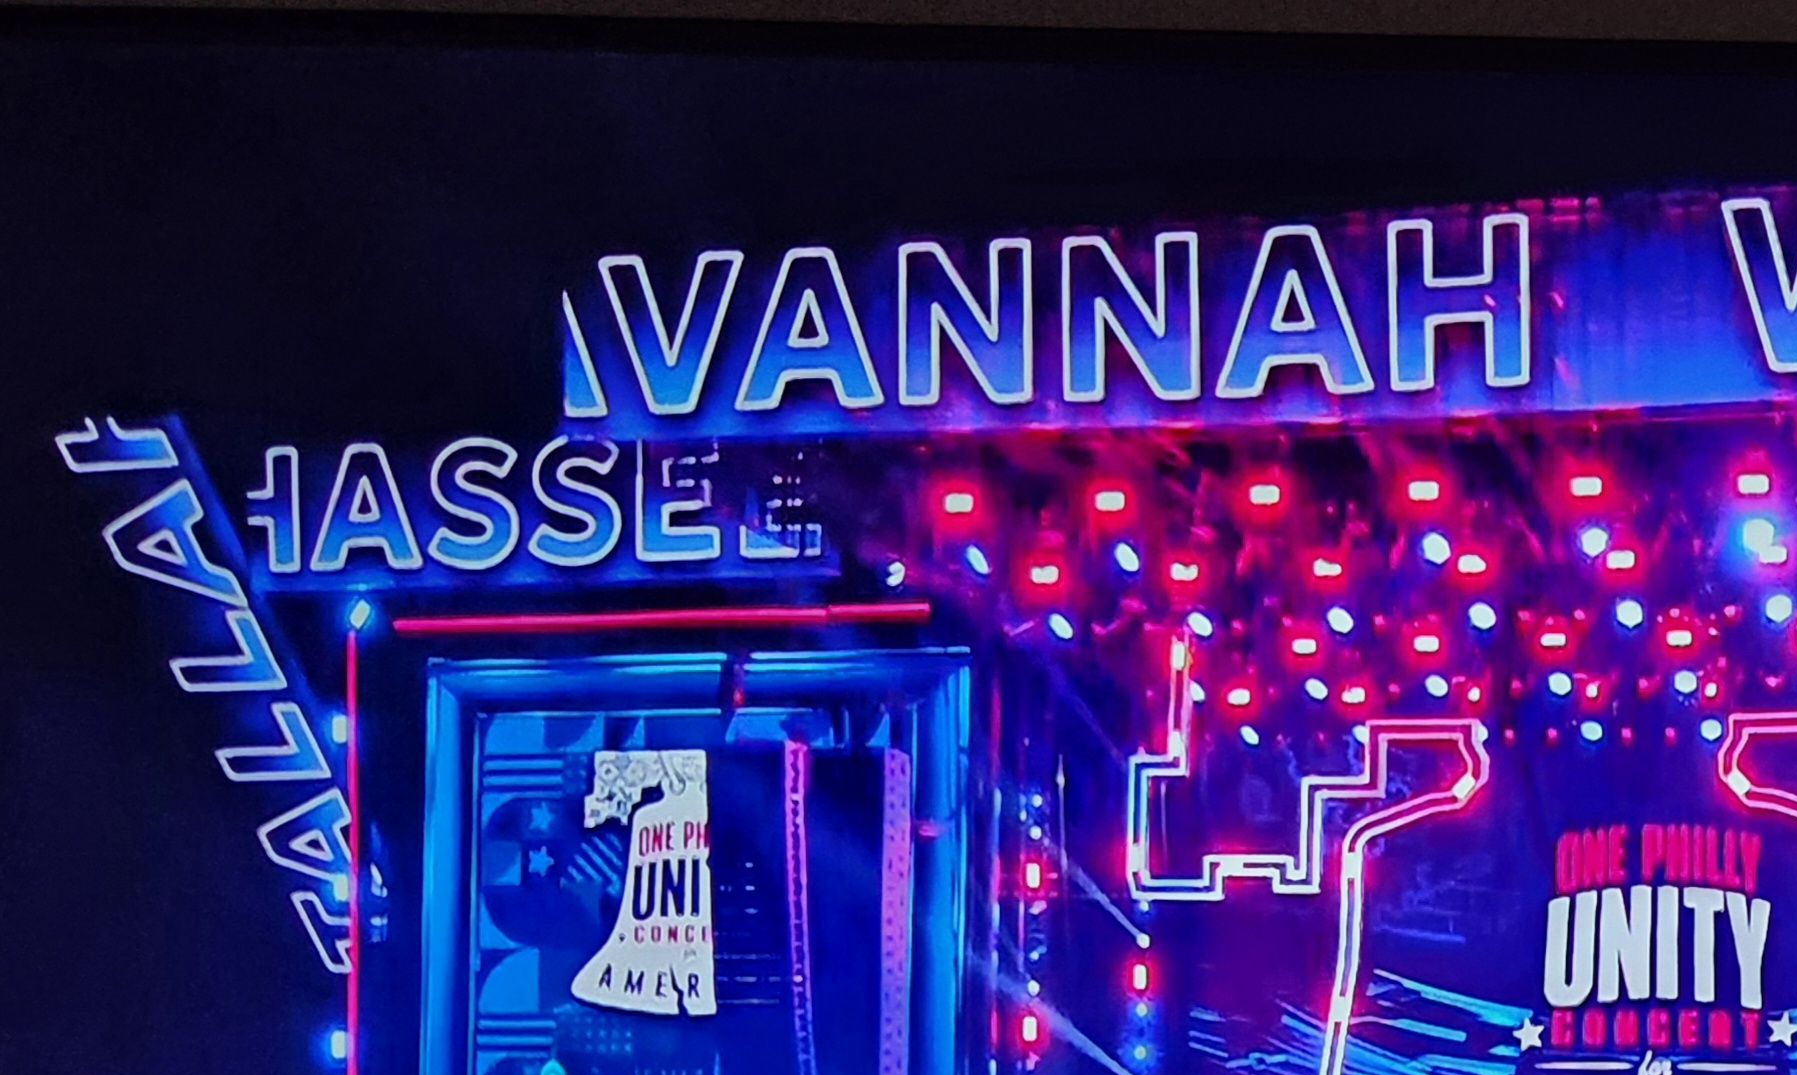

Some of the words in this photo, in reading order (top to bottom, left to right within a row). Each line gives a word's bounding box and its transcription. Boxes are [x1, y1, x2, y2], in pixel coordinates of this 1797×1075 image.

[563, 212, 1530, 420] VANNAH
[638, 821, 676, 857] ONE
[1555, 824, 1627, 895] ONE
[1640, 824, 1762, 894] PHILLY
[632, 857, 701, 921] UNI
[1543, 884, 1772, 1010] UNITY
[599, 963, 701, 999] AMER
[1549, 1007, 1760, 1050] CONCERT
